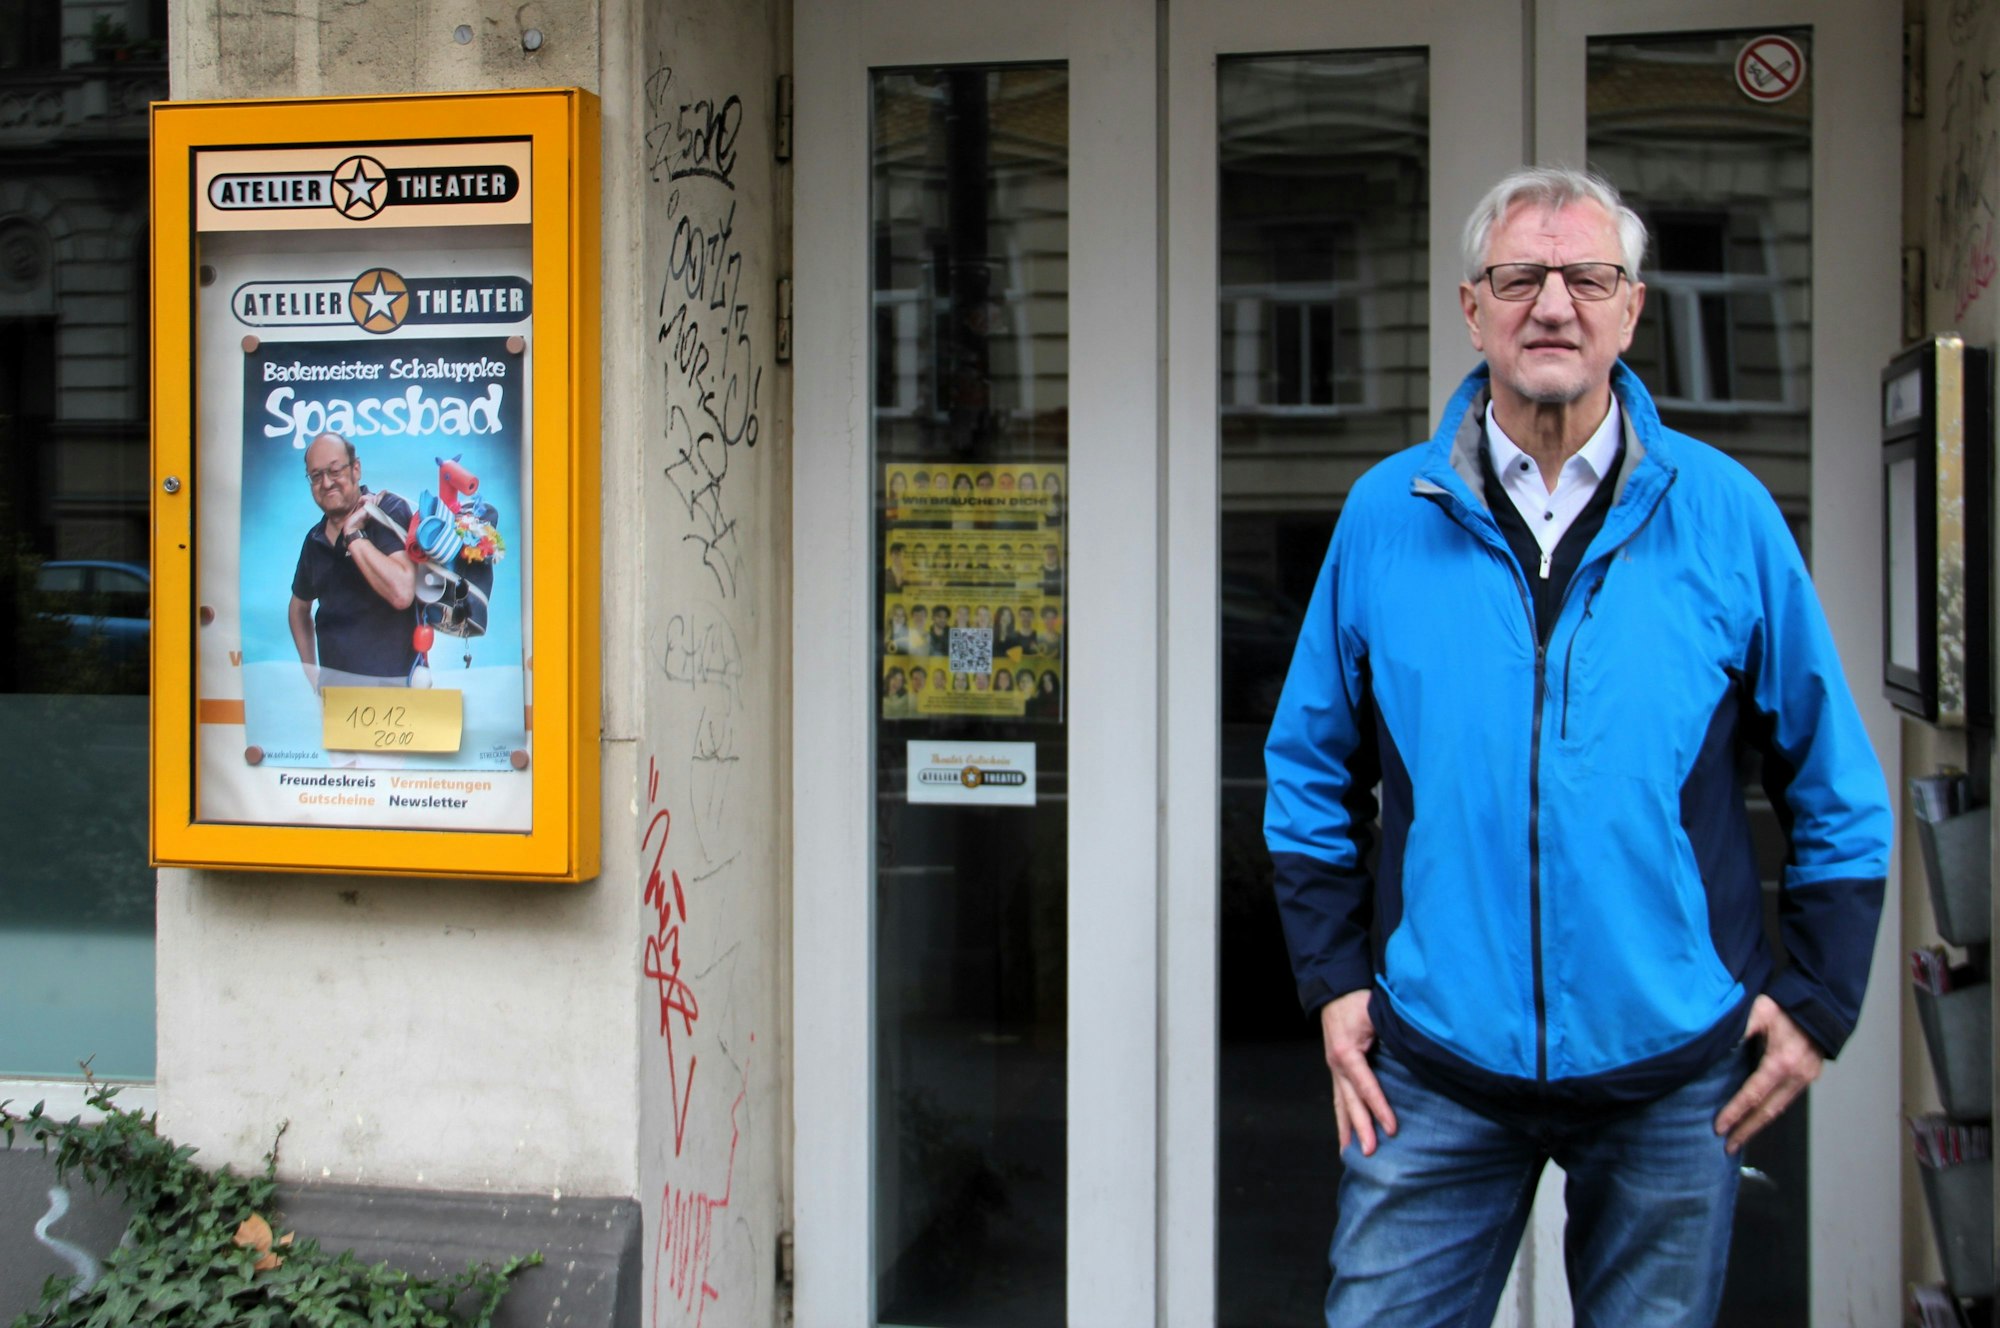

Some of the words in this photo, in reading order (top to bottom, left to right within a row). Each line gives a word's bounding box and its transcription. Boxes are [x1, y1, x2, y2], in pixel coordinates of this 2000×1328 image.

[220, 180, 322, 203] ATELIER
[398, 173, 506, 198] THEATER
[243, 292, 342, 316] ATELIER
[417, 288, 524, 313] THEATER
[263, 360, 384, 382] Bademeister
[389, 357, 506, 382] Schaluppke
[263, 383, 503, 449] Spassbad
[929, 496, 1006, 506] BRAUCHEN
[280, 773, 376, 788] Freundeskreis
[390, 776, 492, 793] Vermietungen
[922, 772, 959, 782] ATELIER
[983, 772, 1024, 784] THEATER
[298, 792, 376, 806] Gutscheine
[389, 795, 469, 808] Newsletter
